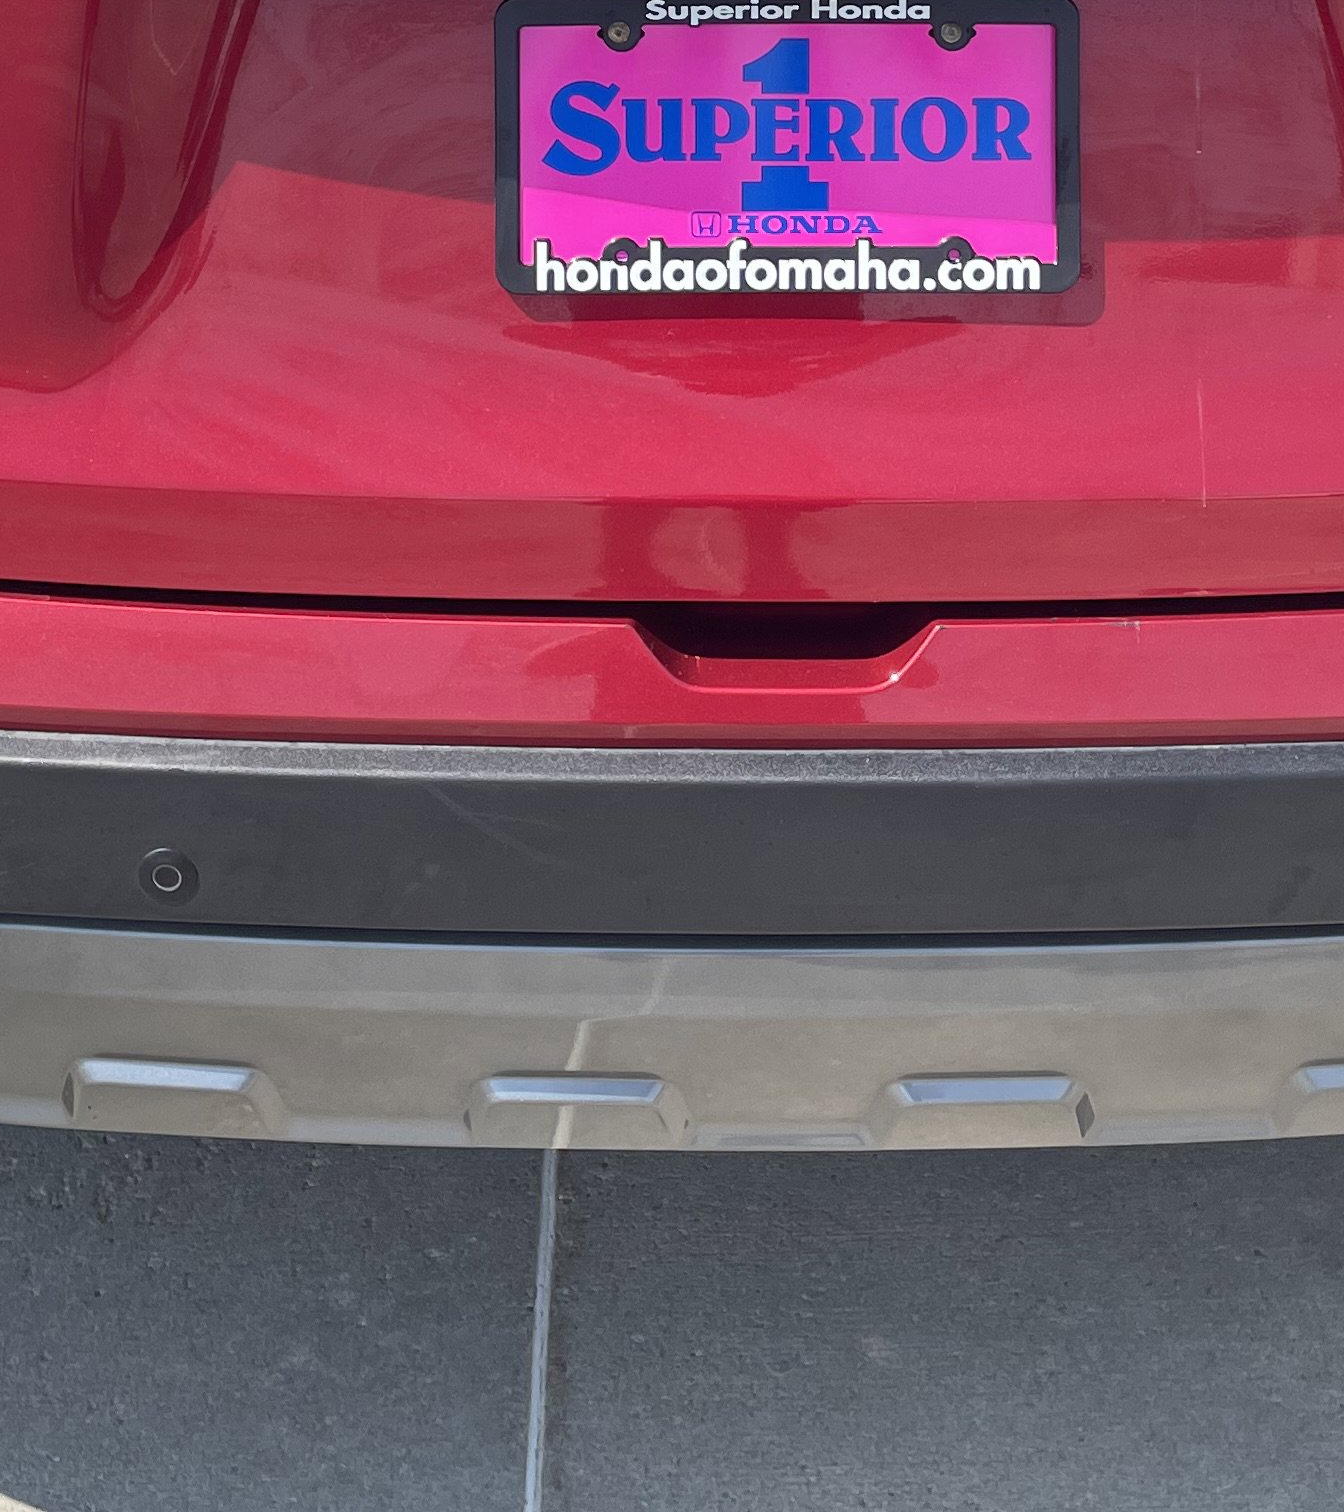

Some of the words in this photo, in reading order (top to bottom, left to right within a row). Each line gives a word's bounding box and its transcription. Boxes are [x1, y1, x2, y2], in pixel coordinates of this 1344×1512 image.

[542, 81, 1033, 176] SUPERIOR
[727, 215, 884, 236] HONDA
[536, 239, 1042, 293] hondaofomaha.com
